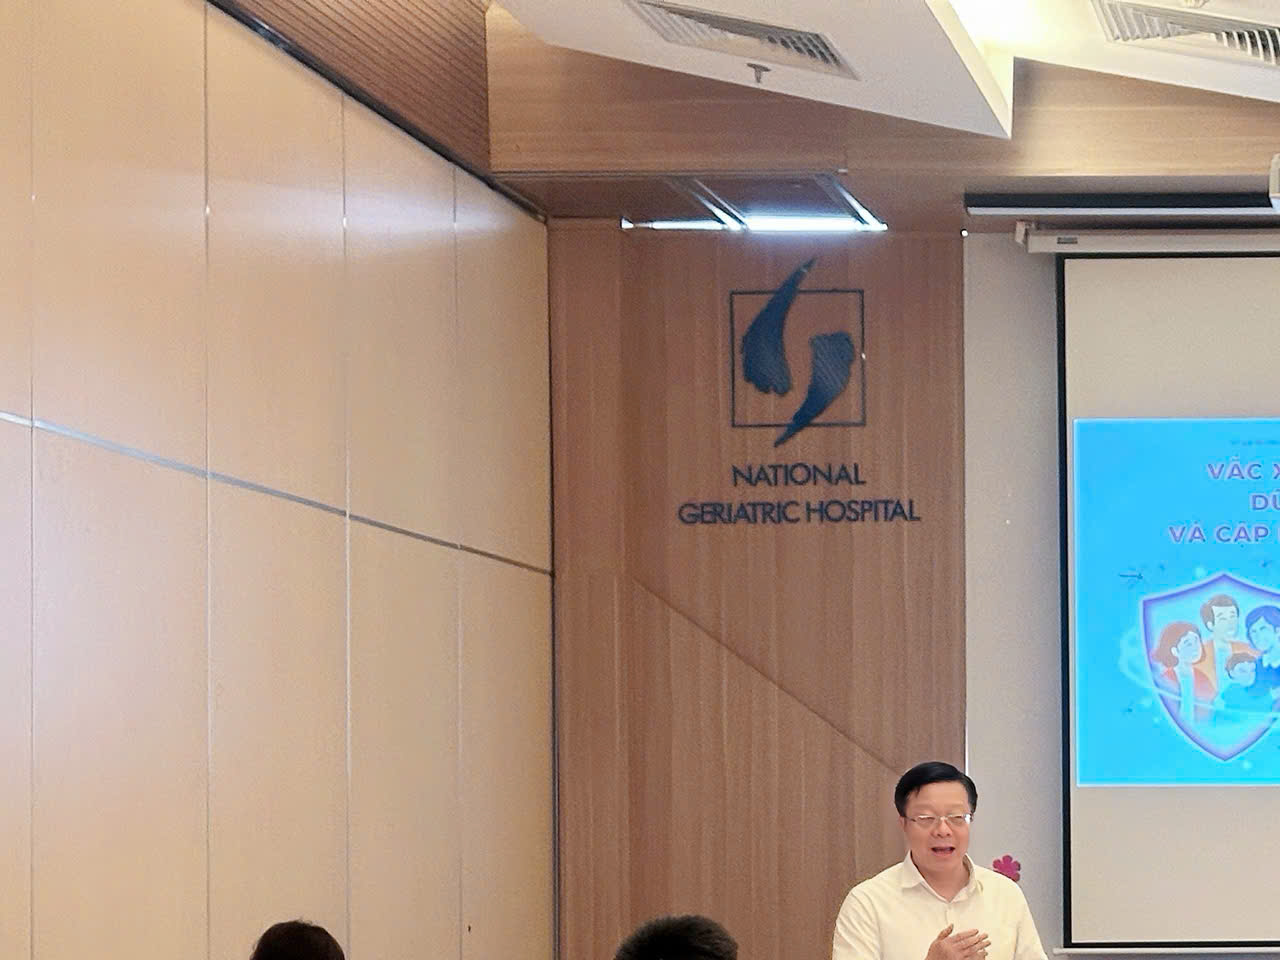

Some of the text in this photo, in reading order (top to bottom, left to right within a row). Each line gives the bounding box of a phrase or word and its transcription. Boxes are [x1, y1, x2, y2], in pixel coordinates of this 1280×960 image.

[732, 462, 866, 487] NATIONAL
[678, 499, 921, 524] GERIATRIC HOSPITAL
[1168, 521, 1206, 542] VÀ
